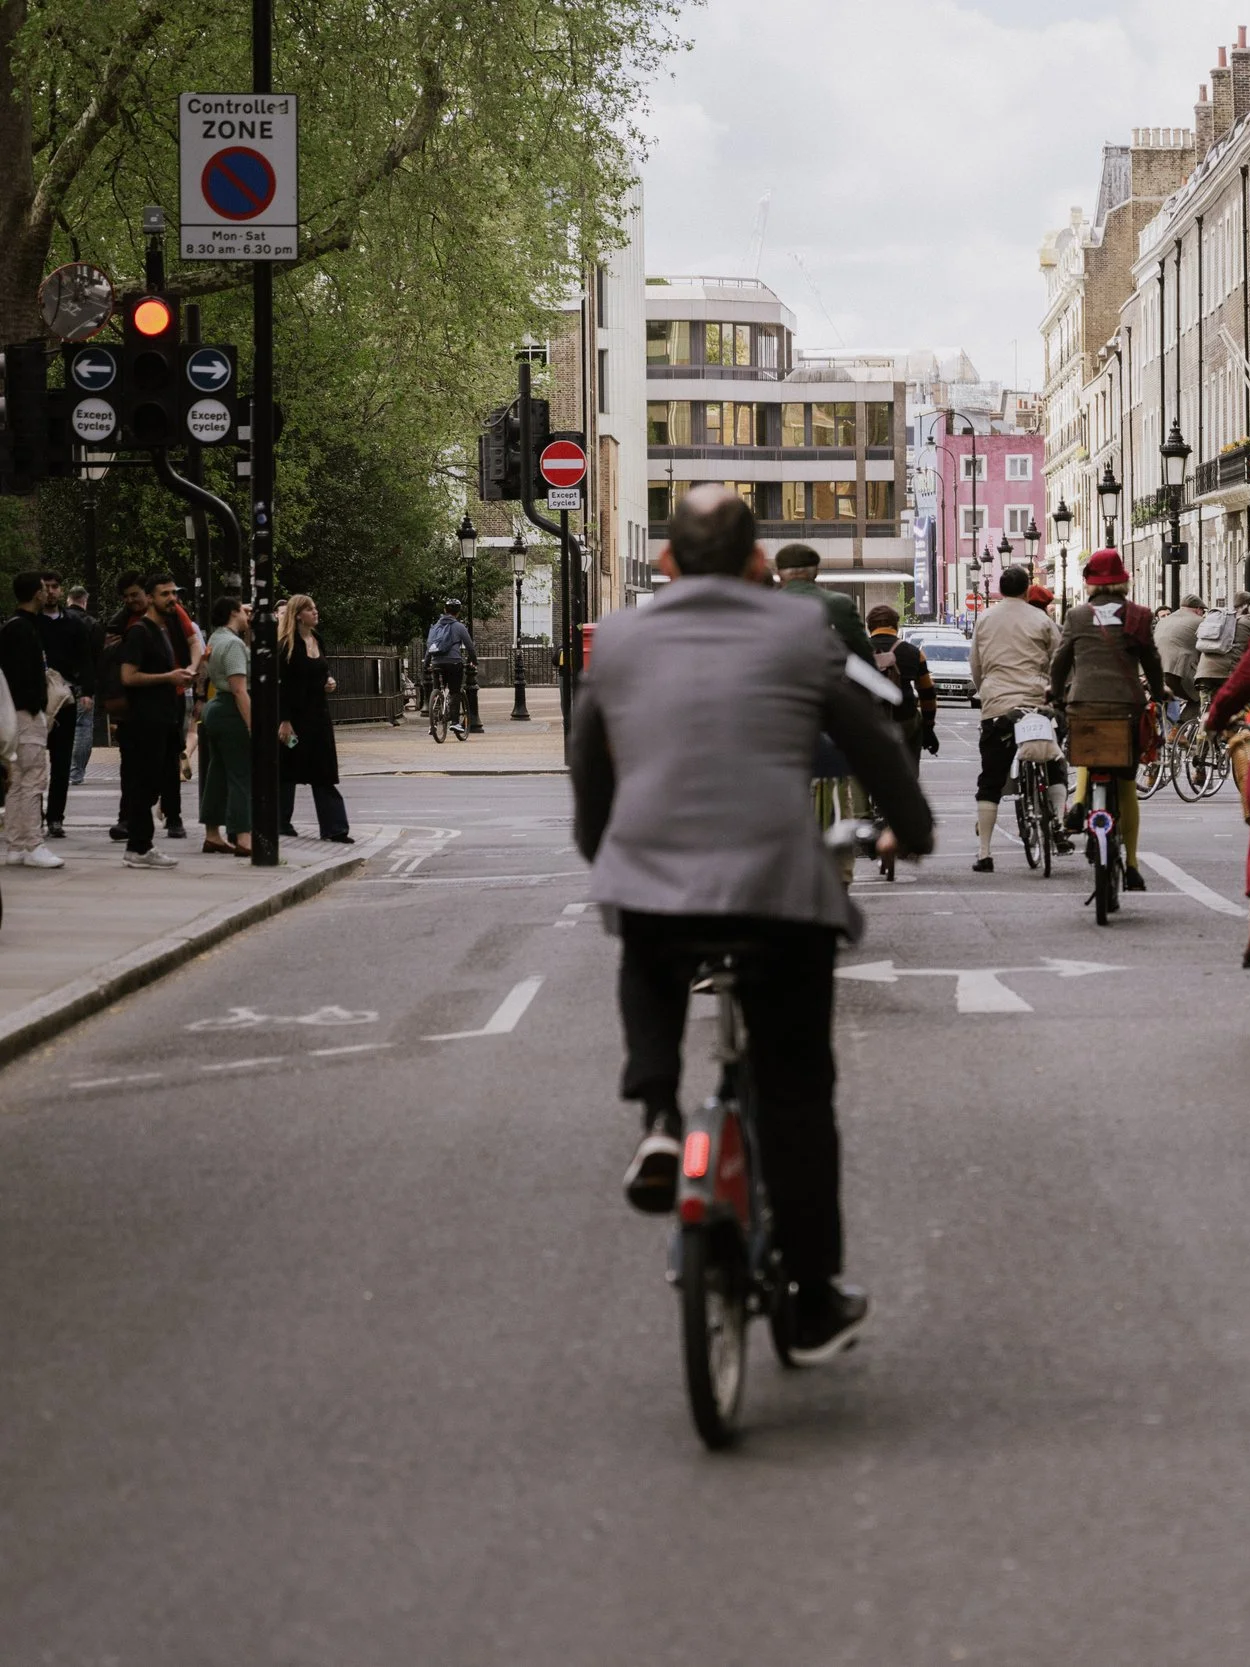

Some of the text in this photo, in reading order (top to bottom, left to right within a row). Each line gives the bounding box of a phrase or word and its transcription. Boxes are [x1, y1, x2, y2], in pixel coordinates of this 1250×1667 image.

[187, 98, 289, 115] Controlled
[202, 120, 273, 139] ZONE
[186, 244, 215, 254] 8.30
[274, 246, 293, 256] pm
[76, 409, 113, 421] Except
[191, 410, 228, 421] Except
[77, 421, 111, 432] cycles
[192, 422, 226, 433] cycles
